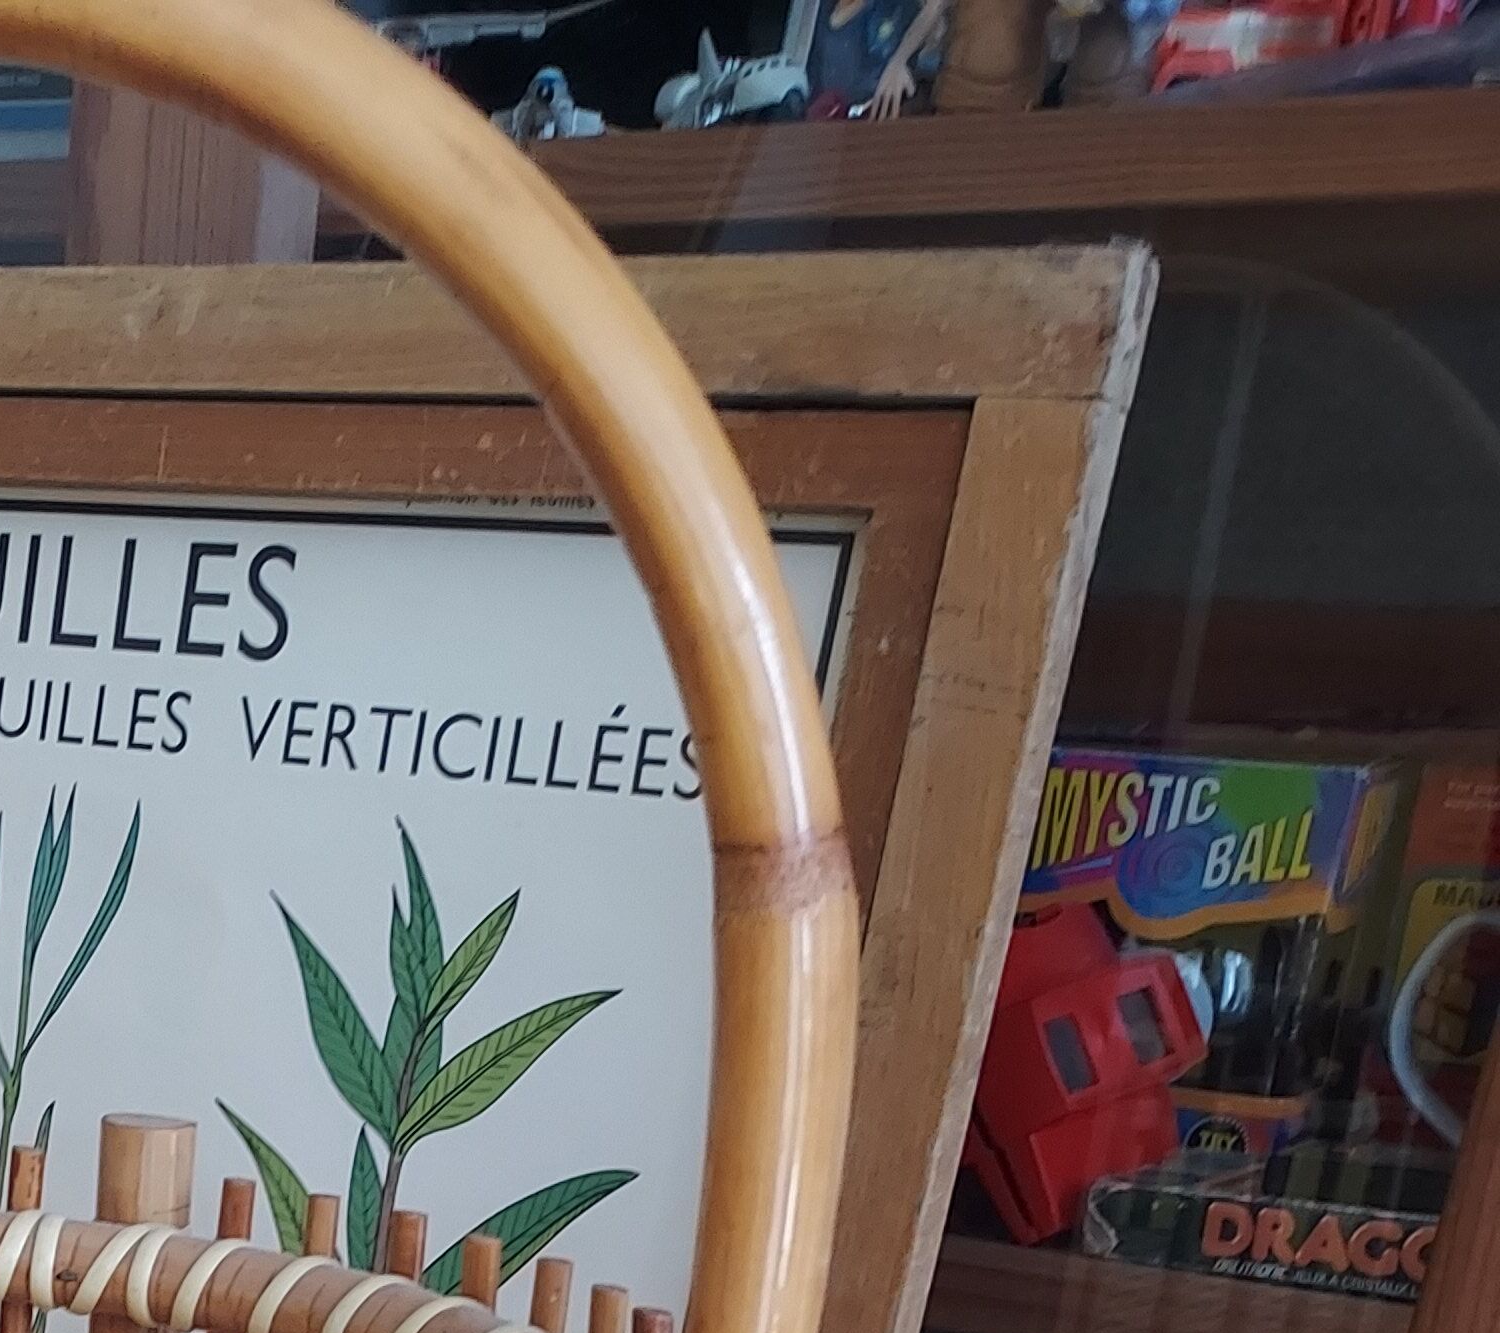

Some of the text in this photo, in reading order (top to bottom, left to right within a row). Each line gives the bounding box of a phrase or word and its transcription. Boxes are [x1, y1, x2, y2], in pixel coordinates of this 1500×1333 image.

[241, 695, 703, 802] VERTICILLÉES
[1030, 766, 1222, 872] MYSTIC
[1201, 809, 1315, 891] BALL
